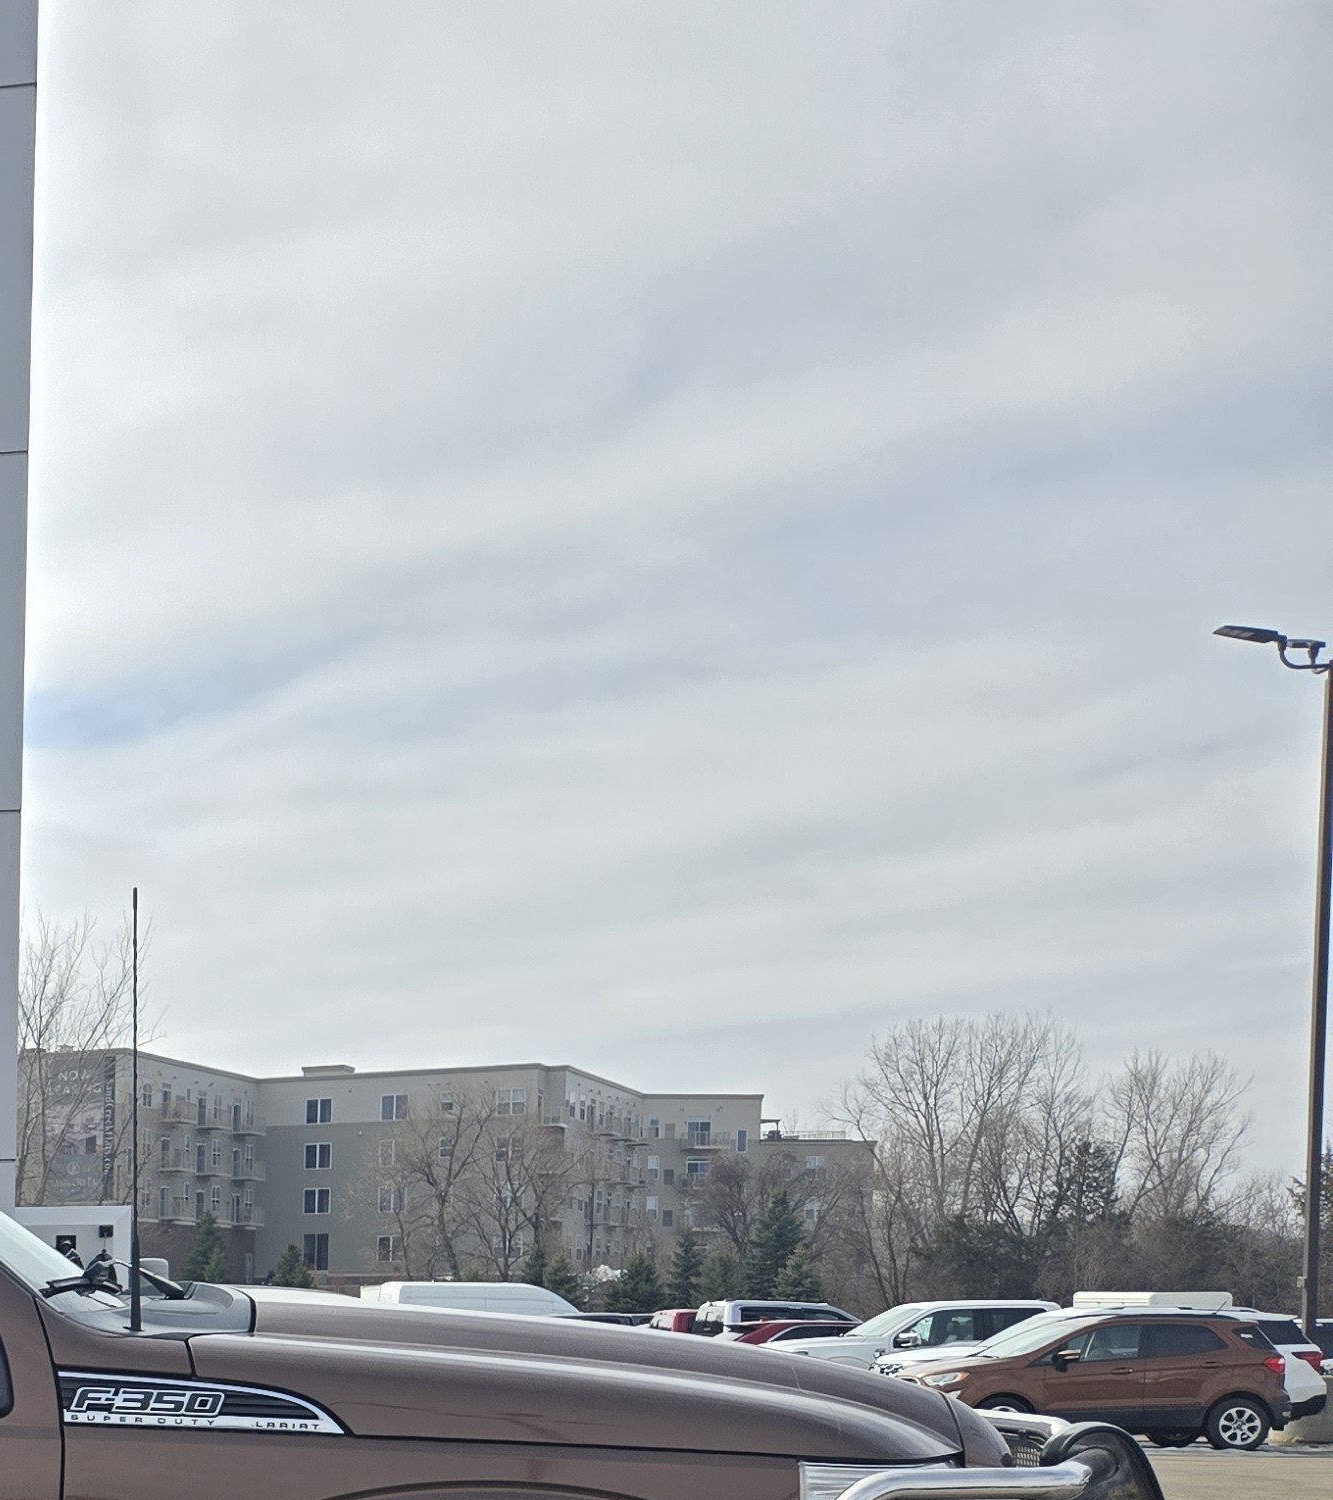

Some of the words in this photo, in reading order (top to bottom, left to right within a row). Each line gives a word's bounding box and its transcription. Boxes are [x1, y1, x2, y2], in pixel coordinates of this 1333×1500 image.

[71, 1414, 143, 1424] SUPER
[157, 1416, 216, 1426] DUTY
[255, 1421, 320, 1430] LARIAT
